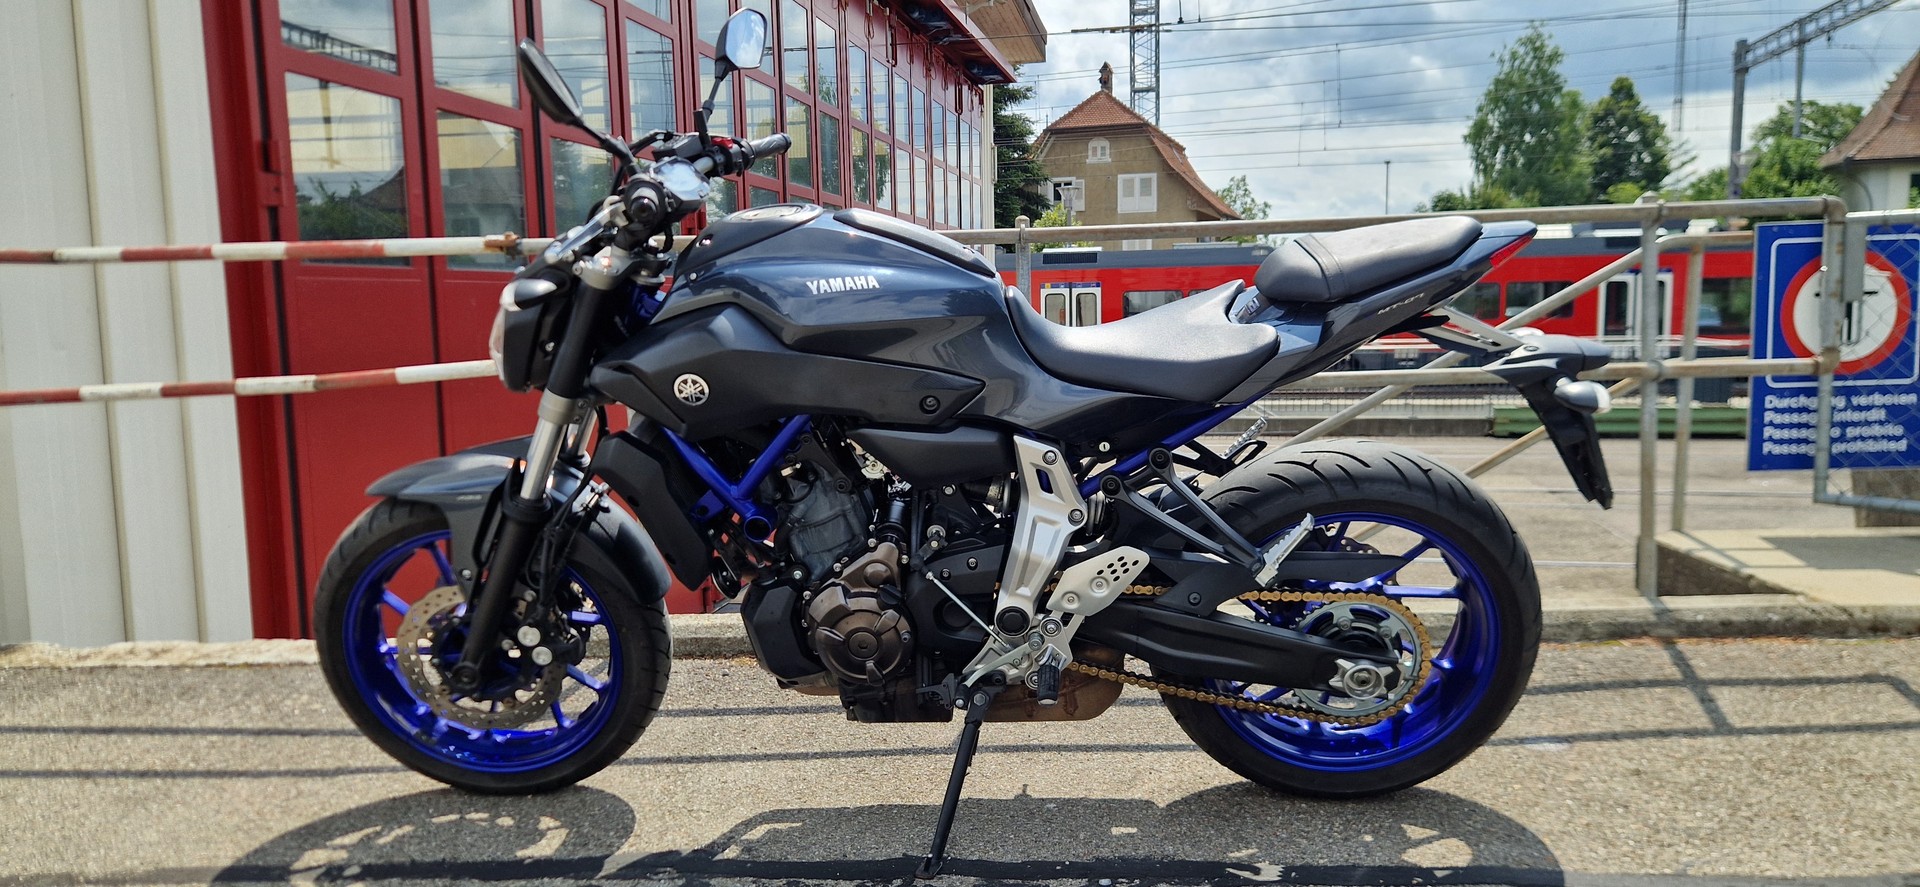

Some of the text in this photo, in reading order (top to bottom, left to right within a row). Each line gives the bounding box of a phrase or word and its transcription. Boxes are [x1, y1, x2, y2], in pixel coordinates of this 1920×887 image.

[806, 275, 880, 295] YAMAHA
[1764, 392, 1917, 410] Durchgng verboten
[1763, 408, 1886, 426] Passag interdit
[1763, 423, 1904, 441] Passago proibito
[1762, 437, 1907, 456] Passag prohibited
